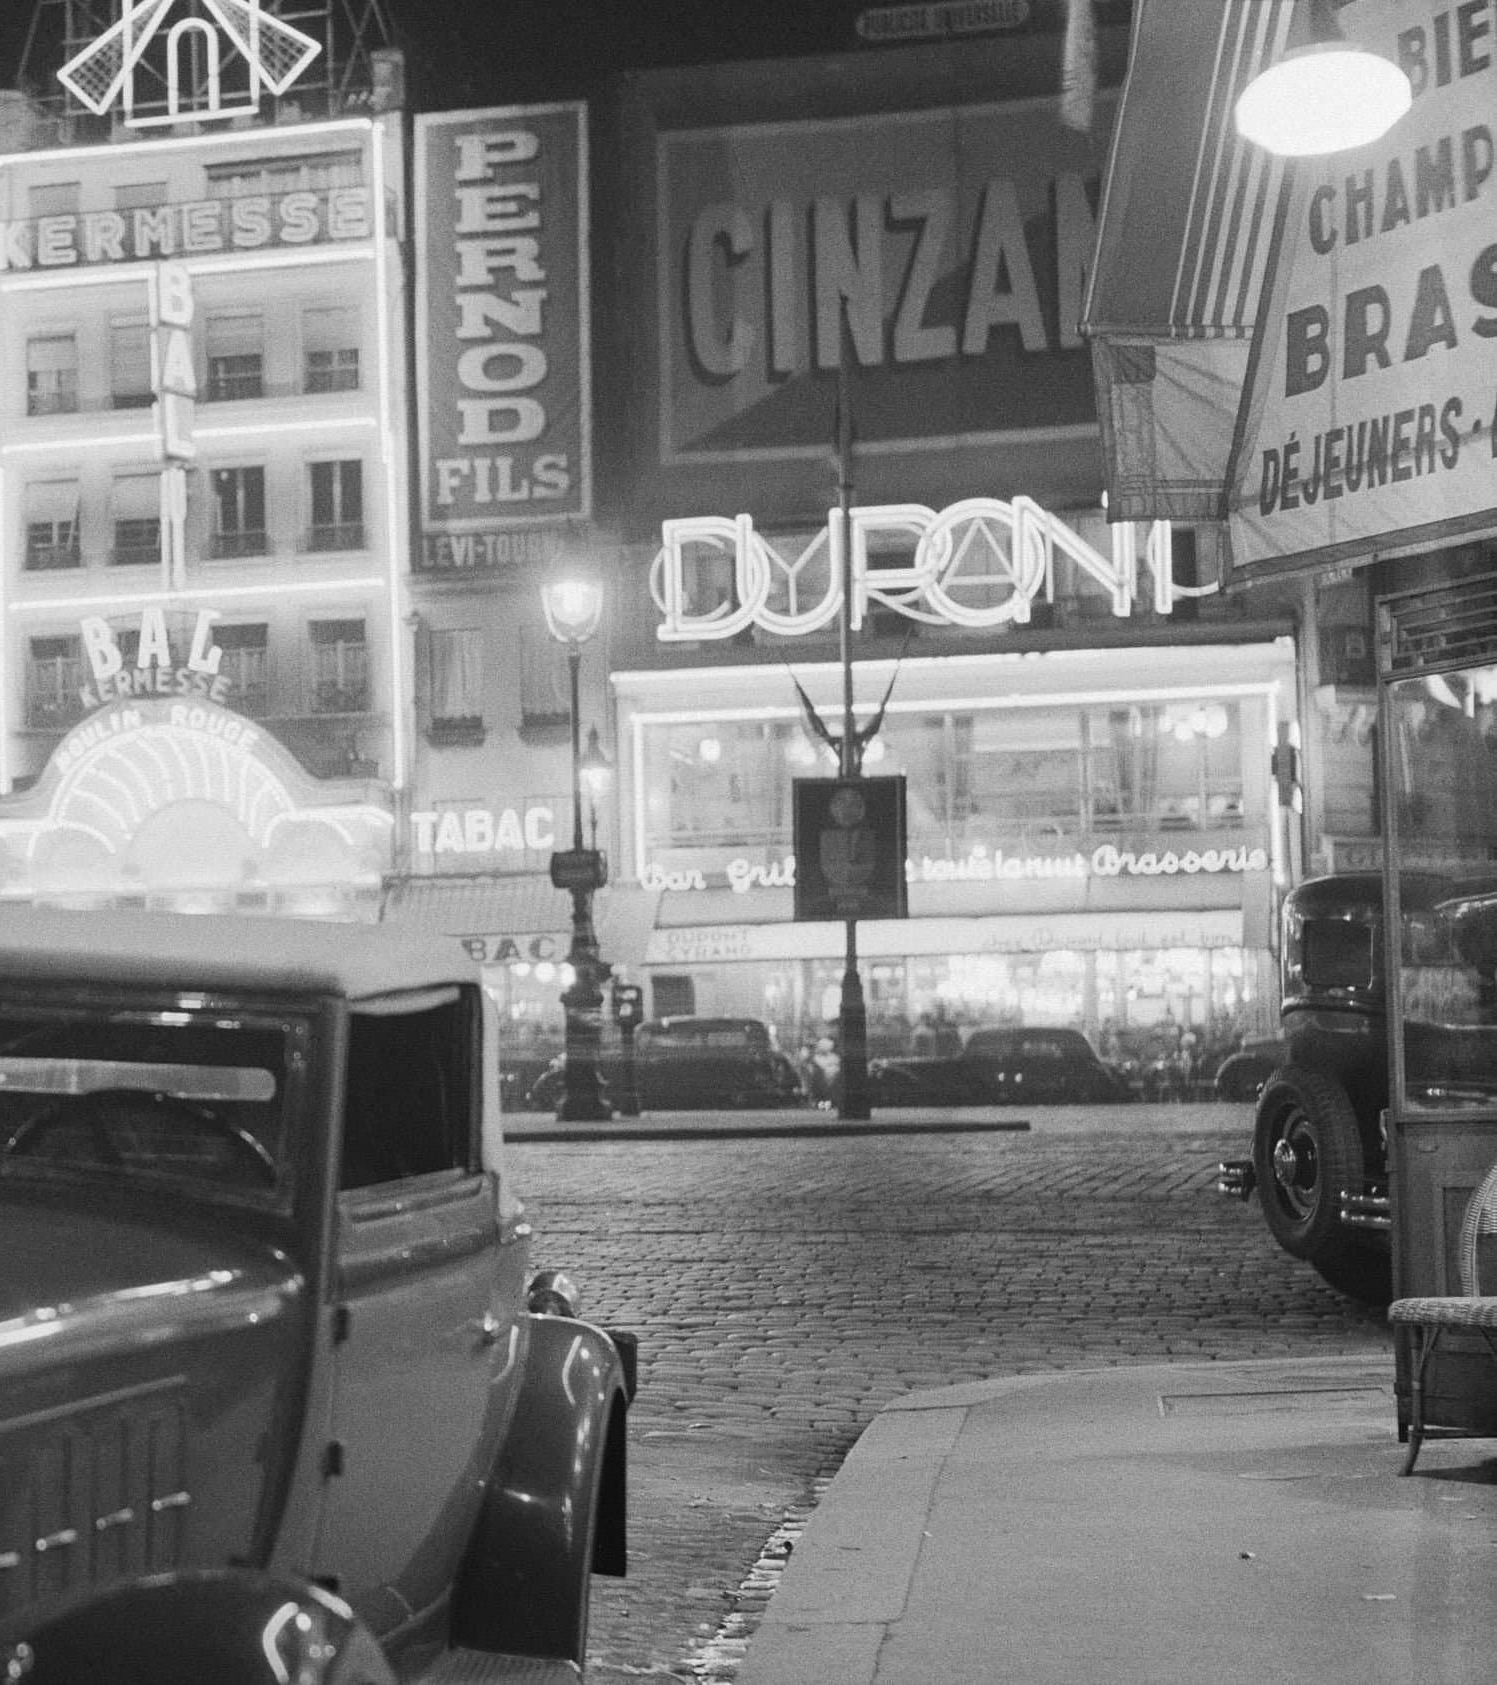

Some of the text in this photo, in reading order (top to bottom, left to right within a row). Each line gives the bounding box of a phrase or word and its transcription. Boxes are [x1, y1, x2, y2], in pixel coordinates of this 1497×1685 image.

[1398, 0, 1497, 100] BIE
[455, 130, 548, 445] PERNOD
[158, 262, 197, 458] BAL
[436, 453, 570, 505] FILS
[1259, 396, 1463, 518] DÉJEUNERS
[80, 606, 223, 681] BAL
[78, 667, 233, 709] KERMESSE
[171, 704, 260, 756] ROUGE
[410, 807, 556, 854] TABAC
[640, 861, 707, 891] Bar
[1091, 844, 1268, 876] Brasserie
